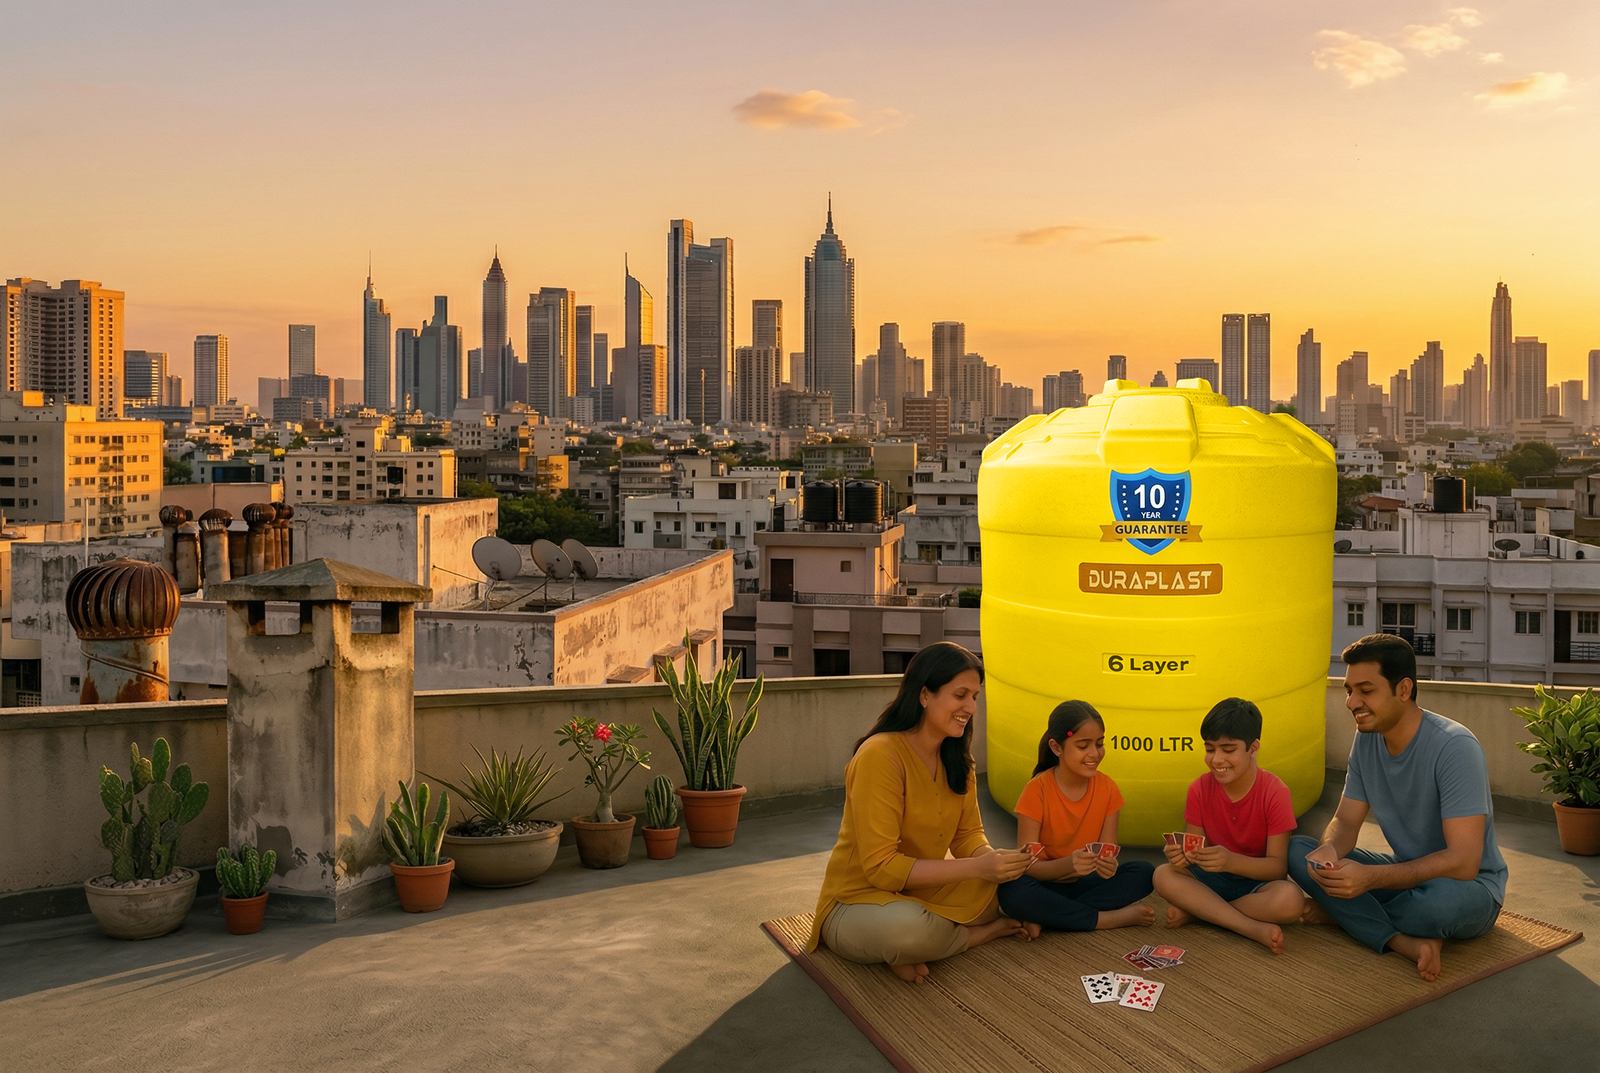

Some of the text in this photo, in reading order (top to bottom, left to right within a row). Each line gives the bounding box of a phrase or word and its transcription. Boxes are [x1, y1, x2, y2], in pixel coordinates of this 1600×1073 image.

[1134, 484, 1166, 509] 10
[1141, 511, 1161, 519] YEAR
[1115, 524, 1188, 534] GUARANTEE
[1089, 569, 1213, 590] DURAPLAST
[1108, 655, 1189, 675] 6 Layer
[1110, 735, 1194, 752] 1000 LTR
